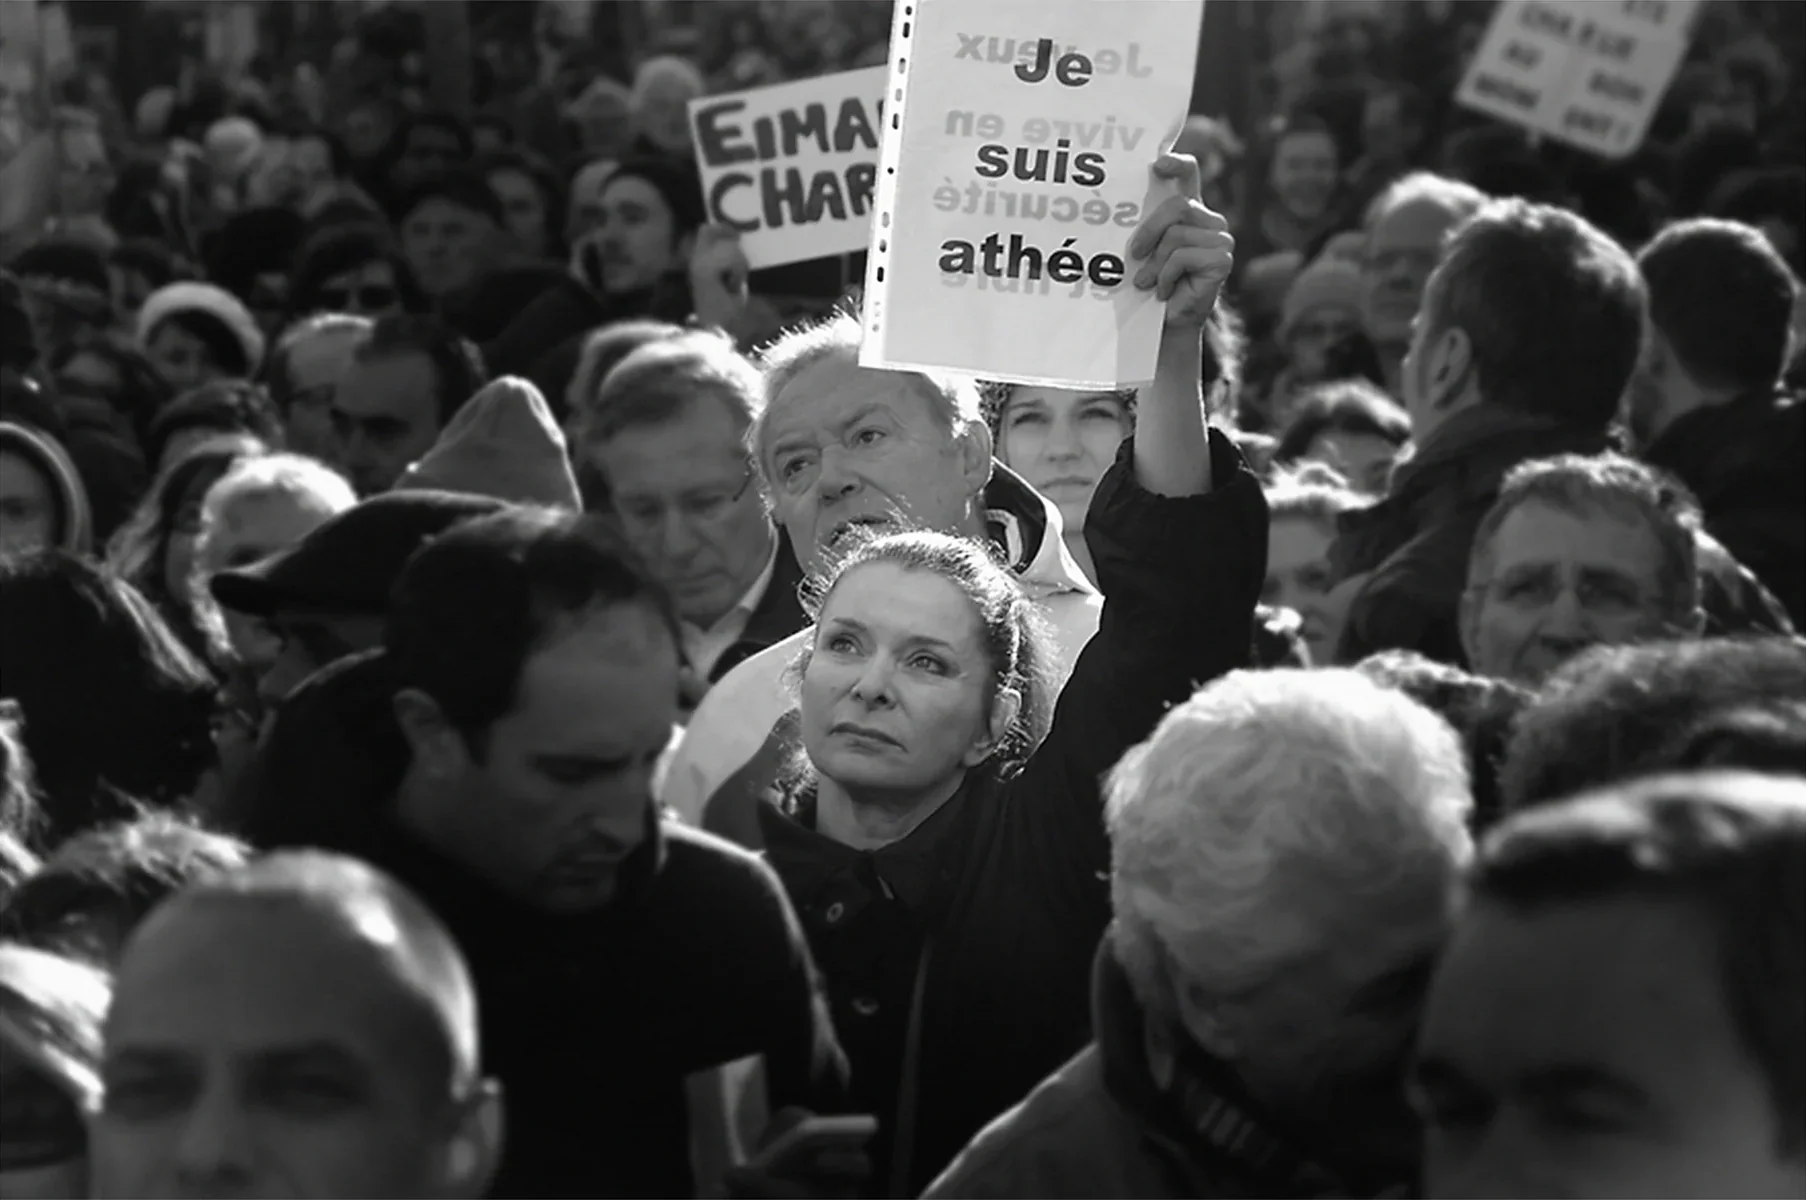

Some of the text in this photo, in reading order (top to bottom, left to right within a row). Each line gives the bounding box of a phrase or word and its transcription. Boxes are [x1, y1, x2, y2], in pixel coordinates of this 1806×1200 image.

[1013, 37, 1094, 87] Je
[696, 97, 884, 167] EIMA
[974, 138, 1107, 187] suis
[710, 162, 876, 232] CHAR
[937, 232, 1126, 287] athée
